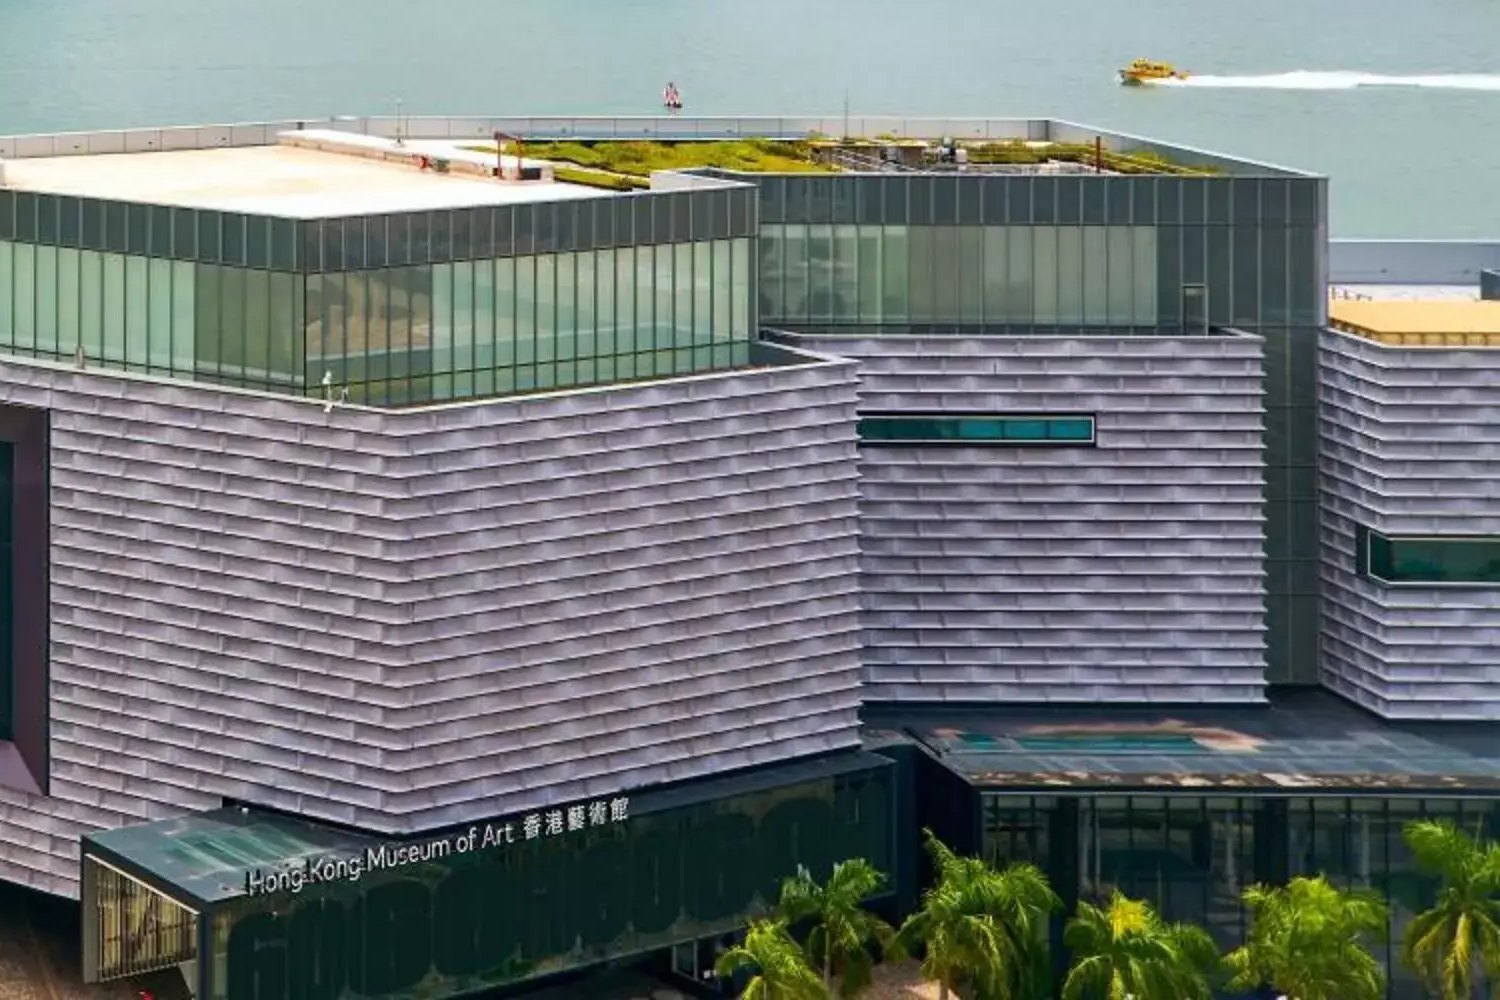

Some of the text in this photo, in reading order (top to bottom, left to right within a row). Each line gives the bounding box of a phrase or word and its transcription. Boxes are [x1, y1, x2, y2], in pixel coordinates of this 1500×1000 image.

[248, 796, 630, 896] Hong Kong Museum of Art 香港藝術館
